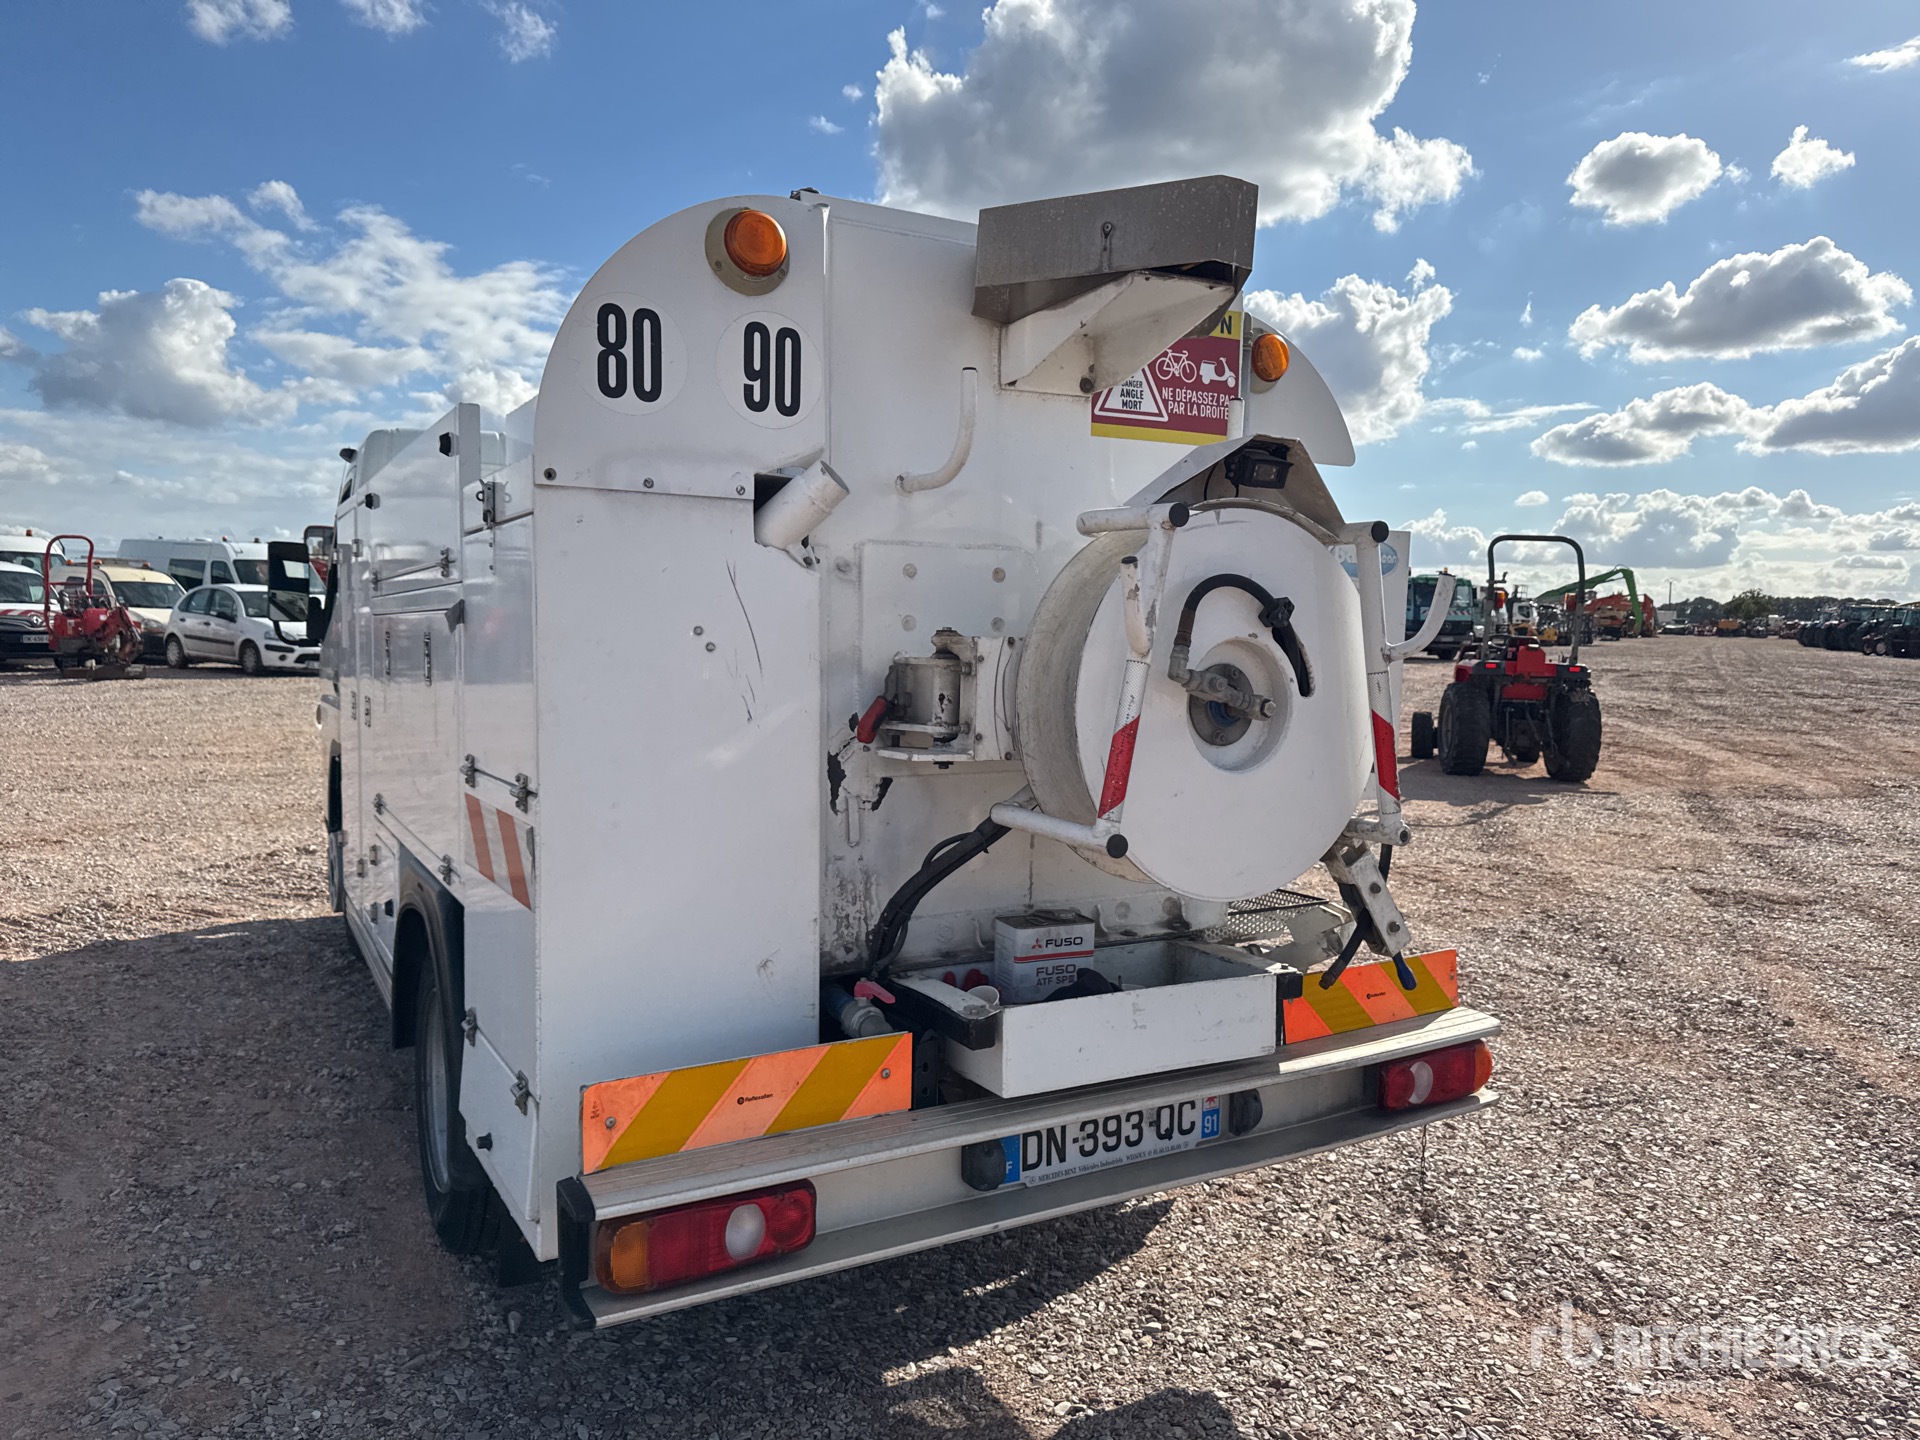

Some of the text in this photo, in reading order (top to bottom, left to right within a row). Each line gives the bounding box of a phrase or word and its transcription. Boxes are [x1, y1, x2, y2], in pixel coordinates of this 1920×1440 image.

[597, 303, 662, 402] 80
[743, 321, 801, 417] 90
[1120, 388, 1144, 400] ANGLE
[1162, 387, 1174, 400] NE
[1175, 387, 1218, 405] DÉPASSEZ
[1121, 399, 1143, 410] MORT
[1168, 401, 1229, 420] PAR LA DROITE
[1045, 936, 1083, 948] FUSO
[1036, 963, 1077, 977] FUSO
[1036, 976, 1053, 986] ATF
[1005, 1160, 1013, 1174] F
[1204, 1114, 1218, 1134] 91
[1038, 1169, 1064, 1181] MERCEDES
[1064, 1167, 1077, 1177] BENZ
